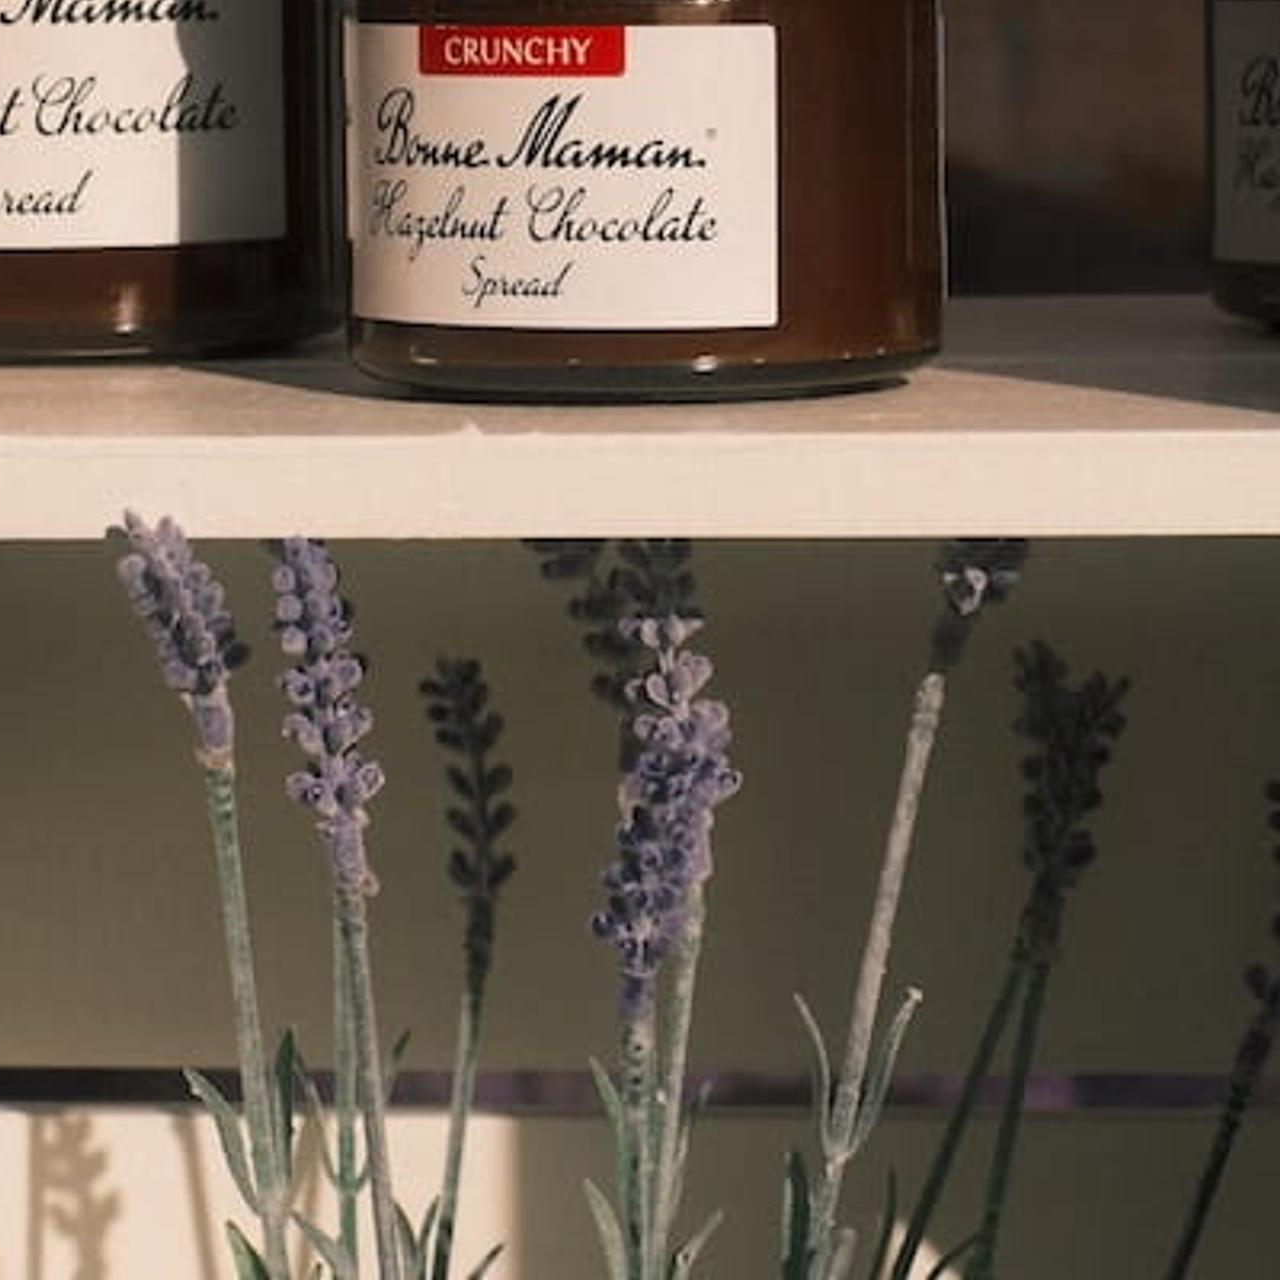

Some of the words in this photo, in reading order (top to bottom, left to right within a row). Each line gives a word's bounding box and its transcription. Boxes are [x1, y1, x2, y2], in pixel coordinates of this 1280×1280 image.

[445, 37, 590, 64] CRUNCHY
[32, 73, 240, 137] Chocolate
[375, 87, 489, 168] Bonne
[369, 178, 506, 262] Hazelnut
[526, 184, 717, 243] Chocolate
[462, 255, 573, 308] Spread
